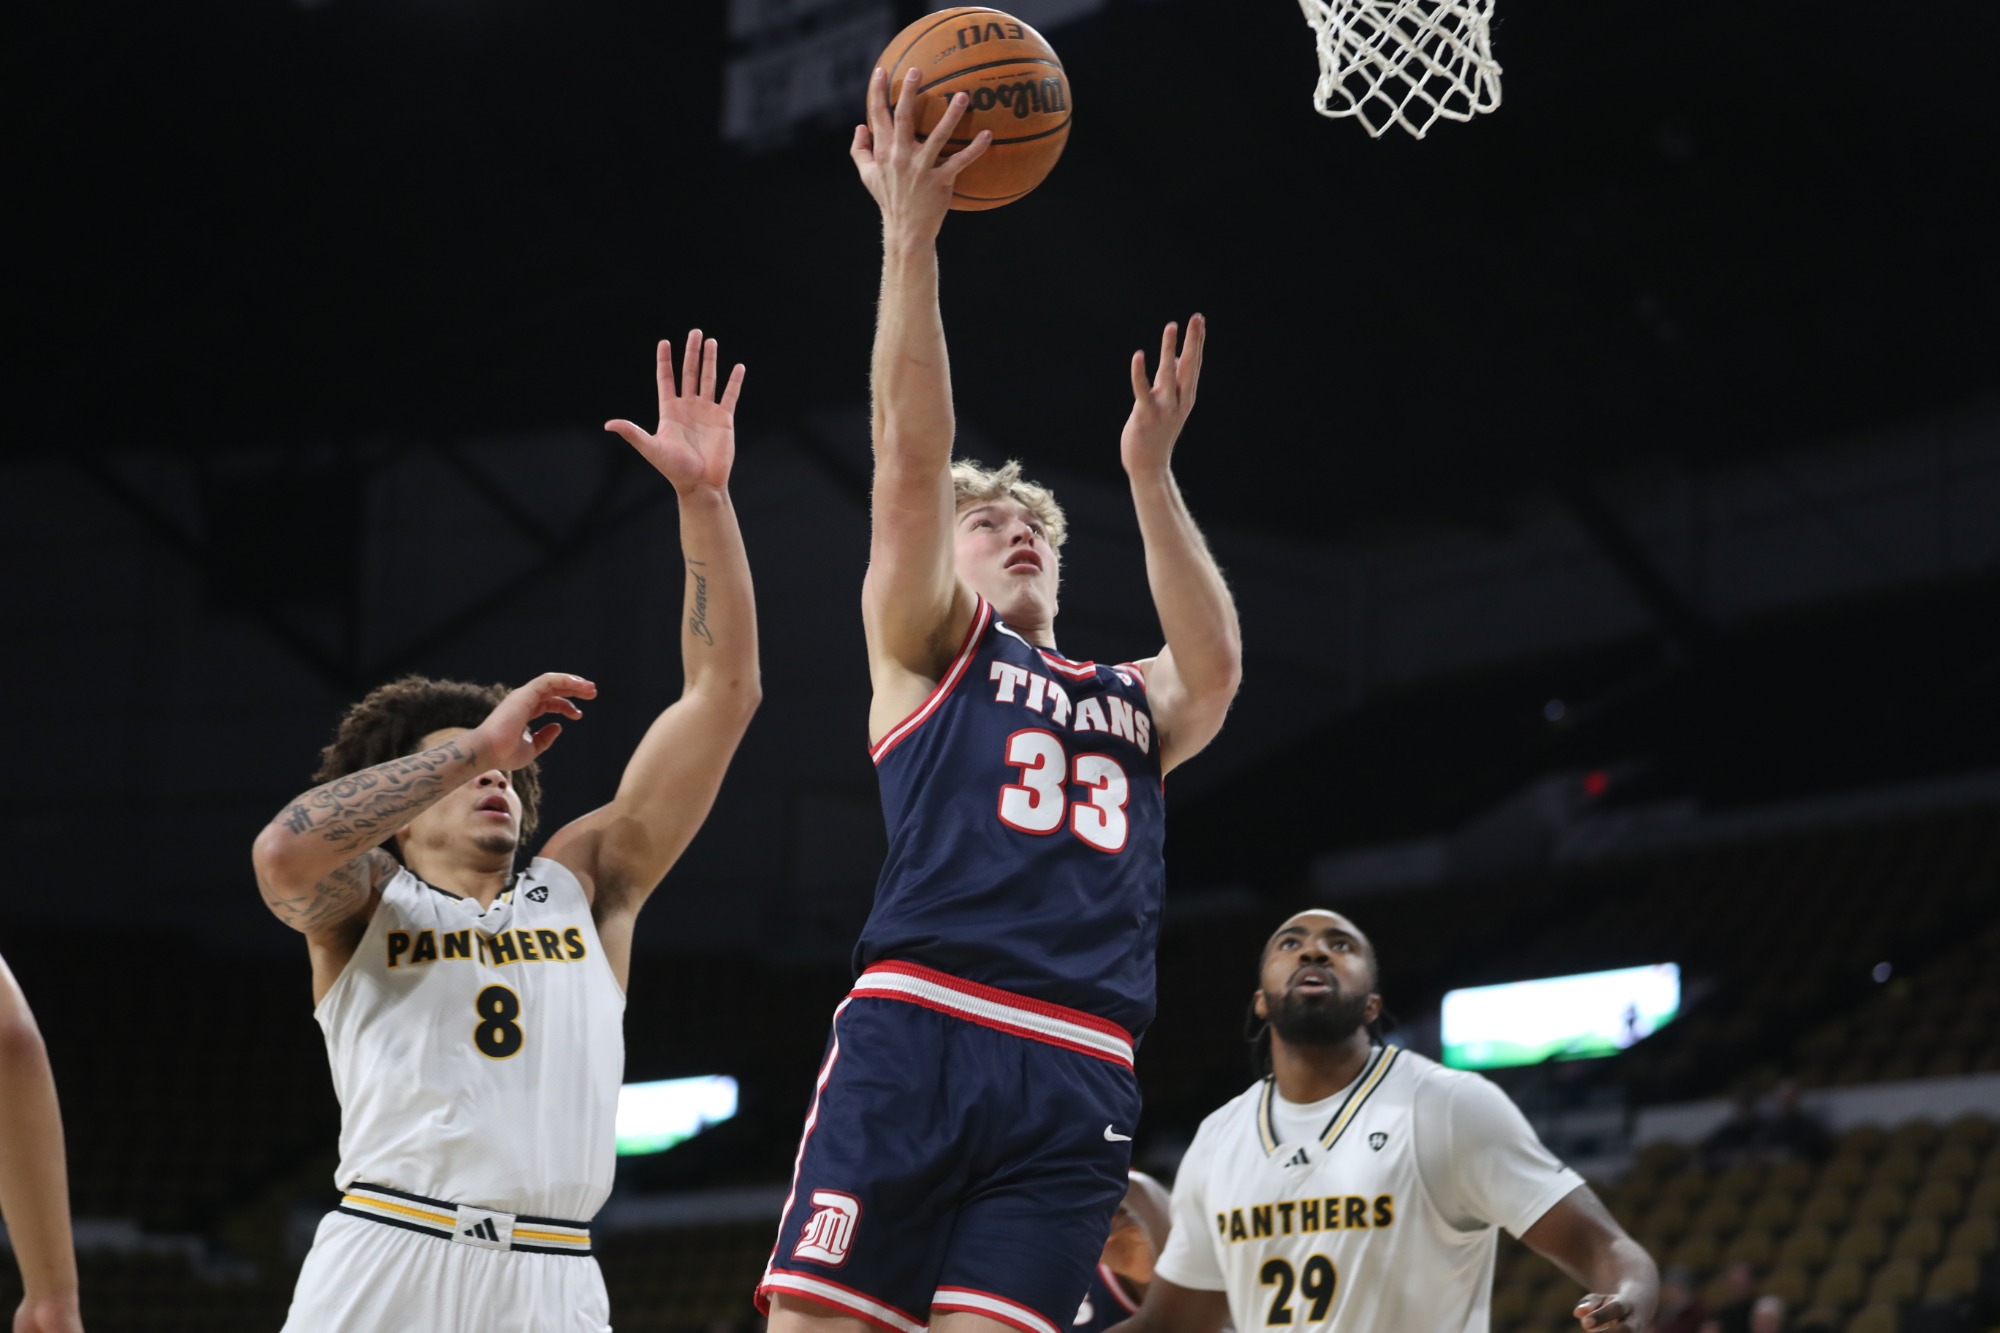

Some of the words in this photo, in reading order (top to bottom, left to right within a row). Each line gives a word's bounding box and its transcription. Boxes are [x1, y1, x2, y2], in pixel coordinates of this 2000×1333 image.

[989, 660, 1150, 755] TITANS
[998, 728, 1130, 854] 33
[473, 983, 525, 1060] 8
[1259, 1253, 1338, 1326] 29
